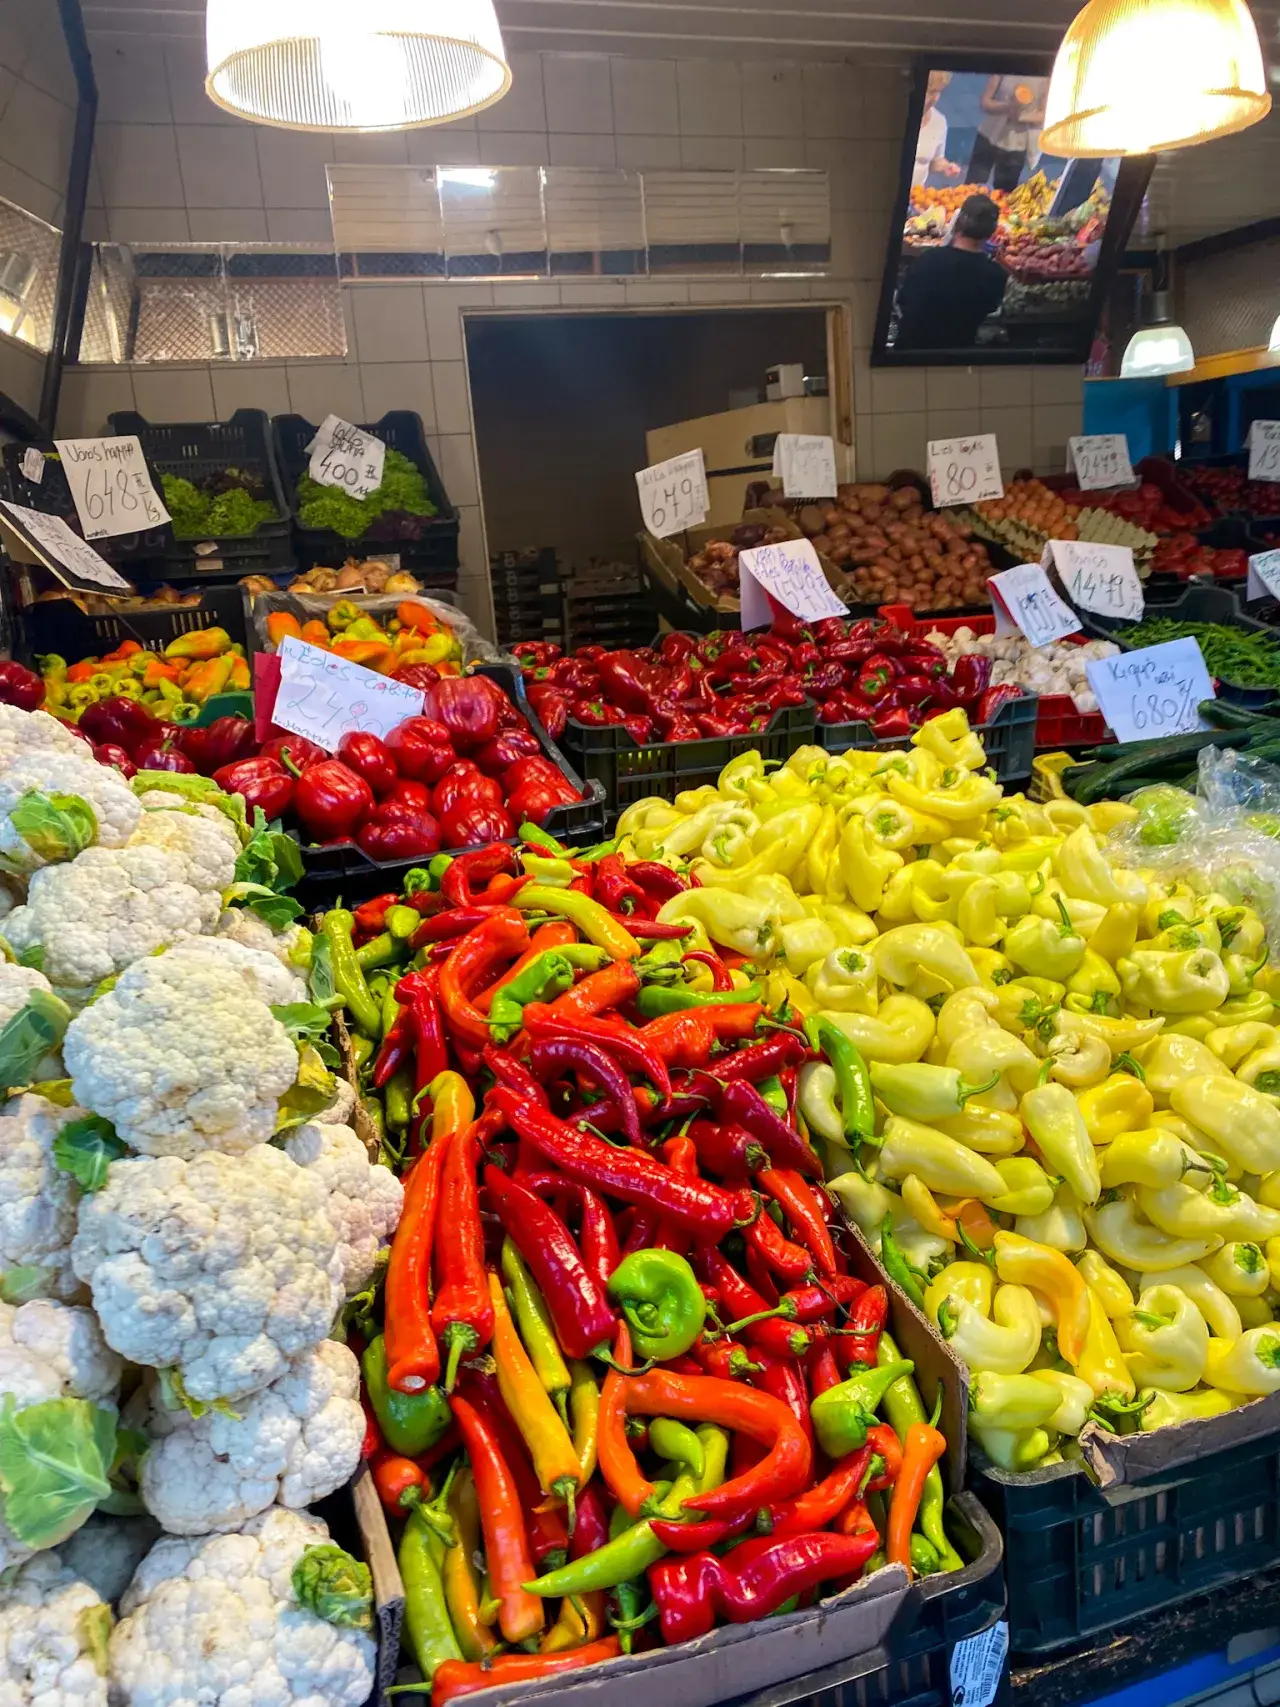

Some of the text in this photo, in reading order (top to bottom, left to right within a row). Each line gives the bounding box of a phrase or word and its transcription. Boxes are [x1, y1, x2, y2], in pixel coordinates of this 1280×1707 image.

[320, 450, 359, 486] 400
[947, 462, 978, 496] 80
[85, 468, 138, 520] 648
[1132, 694, 1180, 730] 680
